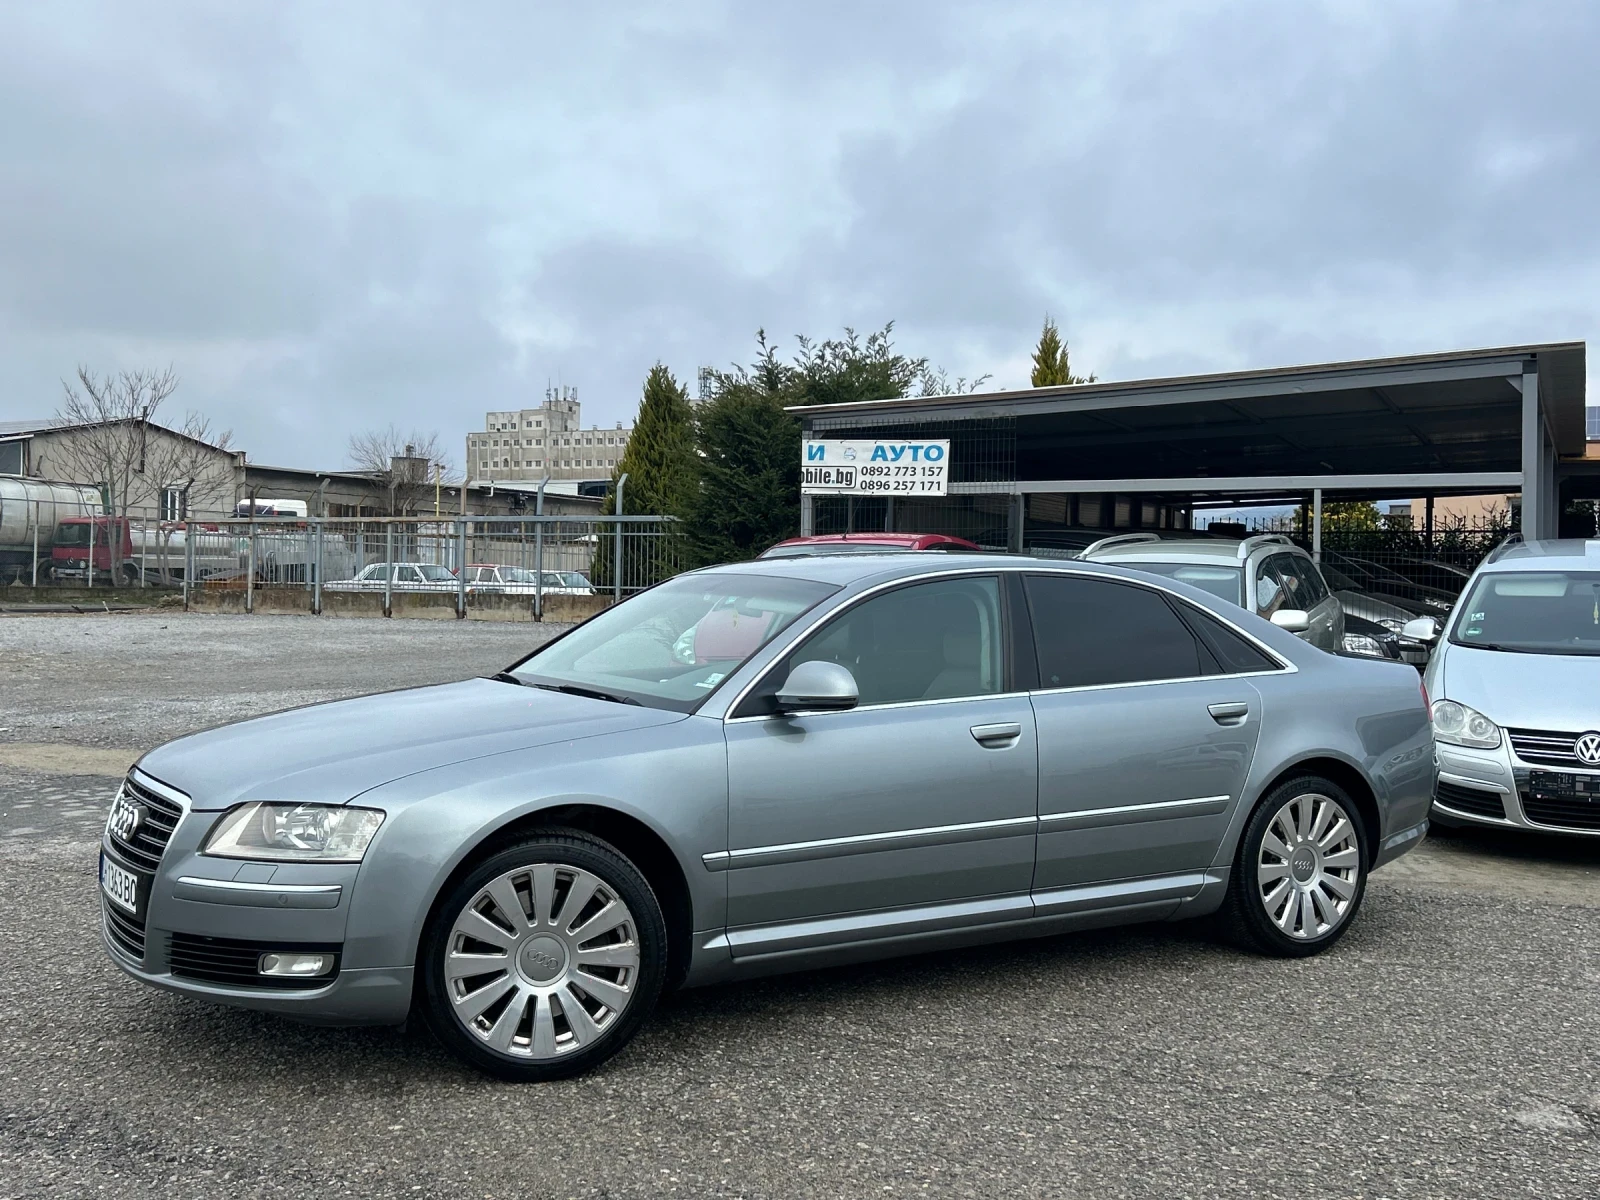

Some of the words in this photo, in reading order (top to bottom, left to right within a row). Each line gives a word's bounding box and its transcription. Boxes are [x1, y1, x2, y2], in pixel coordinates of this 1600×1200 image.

[807, 444, 825, 461] И
[870, 445, 944, 462] АУТО
[861, 466, 891, 476] 0892
[894, 466, 917, 477] 773
[921, 466, 943, 477] 157
[860, 480, 891, 491] 0896
[893, 480, 916, 491] 257
[920, 480, 941, 491] 171
